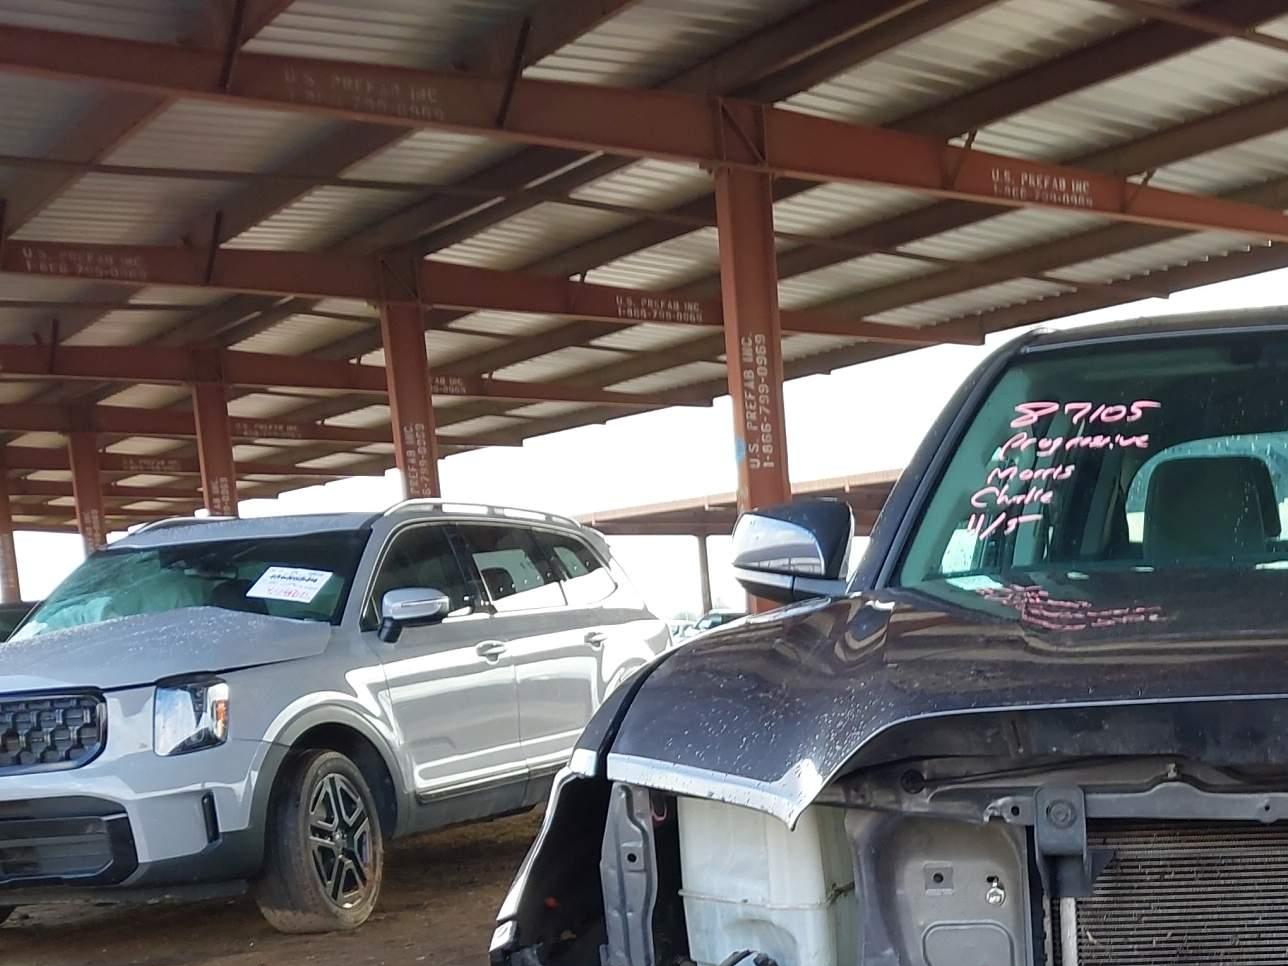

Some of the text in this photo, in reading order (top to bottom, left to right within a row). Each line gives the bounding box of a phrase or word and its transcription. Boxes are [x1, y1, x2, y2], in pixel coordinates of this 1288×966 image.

[1021, 172, 1067, 191] PREFAB
[641, 297, 680, 311] PREFAB
[744, 369, 758, 432] PREFAB
[755, 333, 775, 469] 1-866-799-0969
